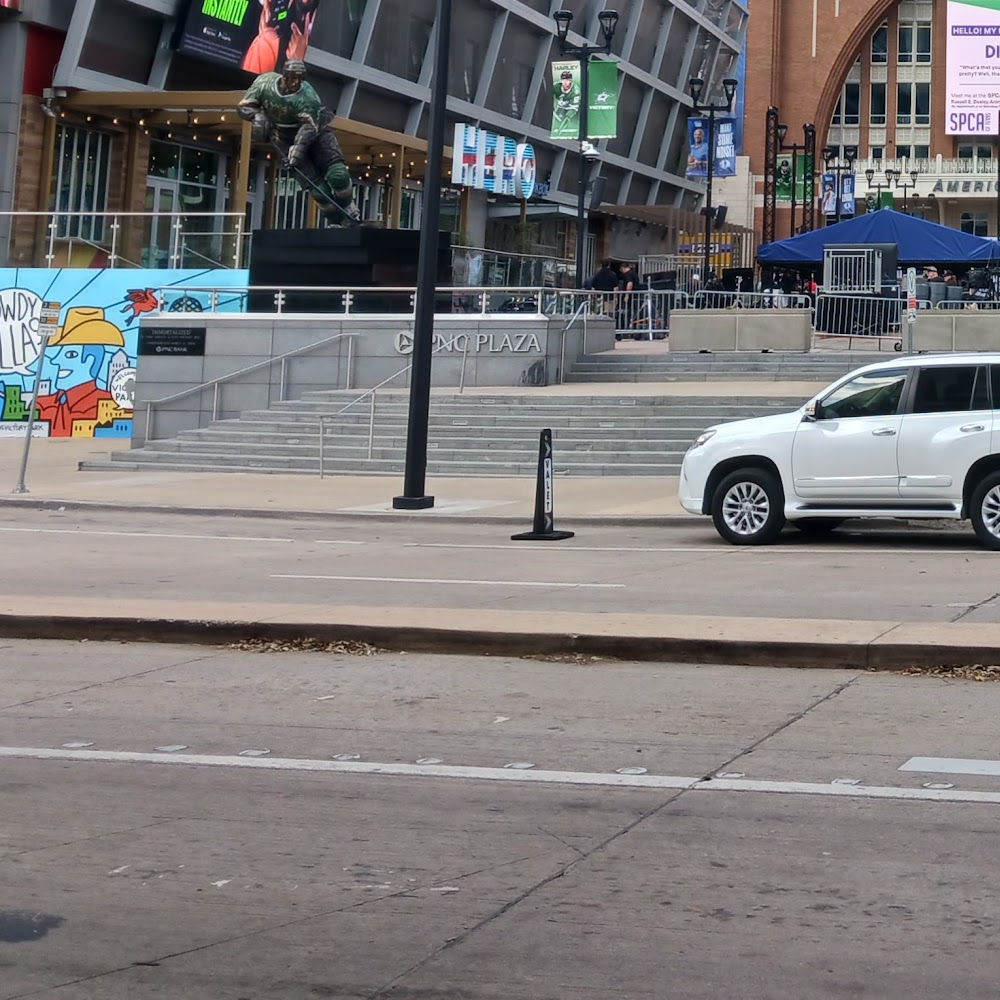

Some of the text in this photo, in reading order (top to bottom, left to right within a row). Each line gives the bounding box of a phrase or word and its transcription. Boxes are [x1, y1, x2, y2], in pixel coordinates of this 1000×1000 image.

[953, 27, 982, 35] HELLO!
[984, 27, 996, 35] MY
[950, 113, 984, 131] SPCA
[476, 334, 541, 352] PLAZA
